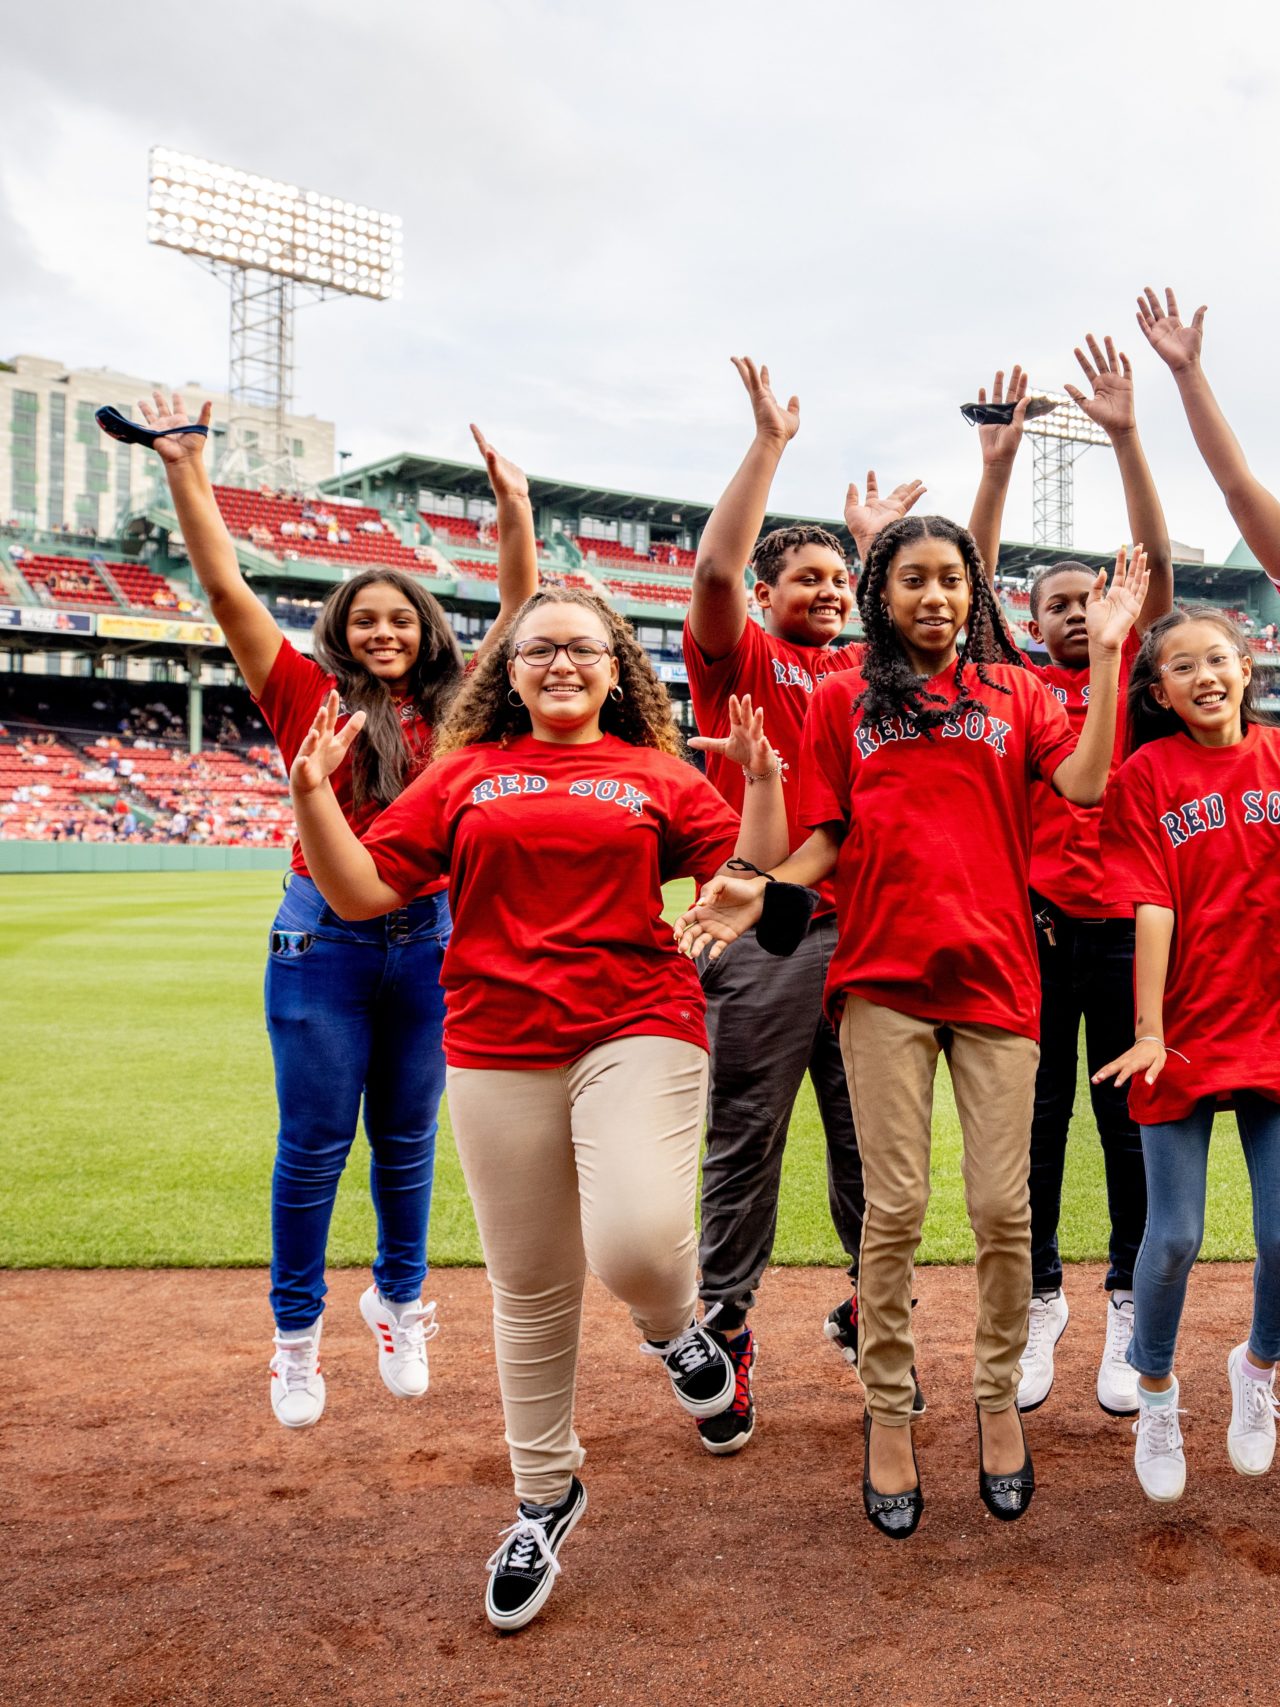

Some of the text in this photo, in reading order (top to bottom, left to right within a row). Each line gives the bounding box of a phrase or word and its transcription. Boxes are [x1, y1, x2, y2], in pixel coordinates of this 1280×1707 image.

[771, 658, 813, 693] RED
[854, 711, 1012, 759] RED SOX
[472, 773, 651, 814] RED SOX
[1160, 793, 1226, 848] RED
